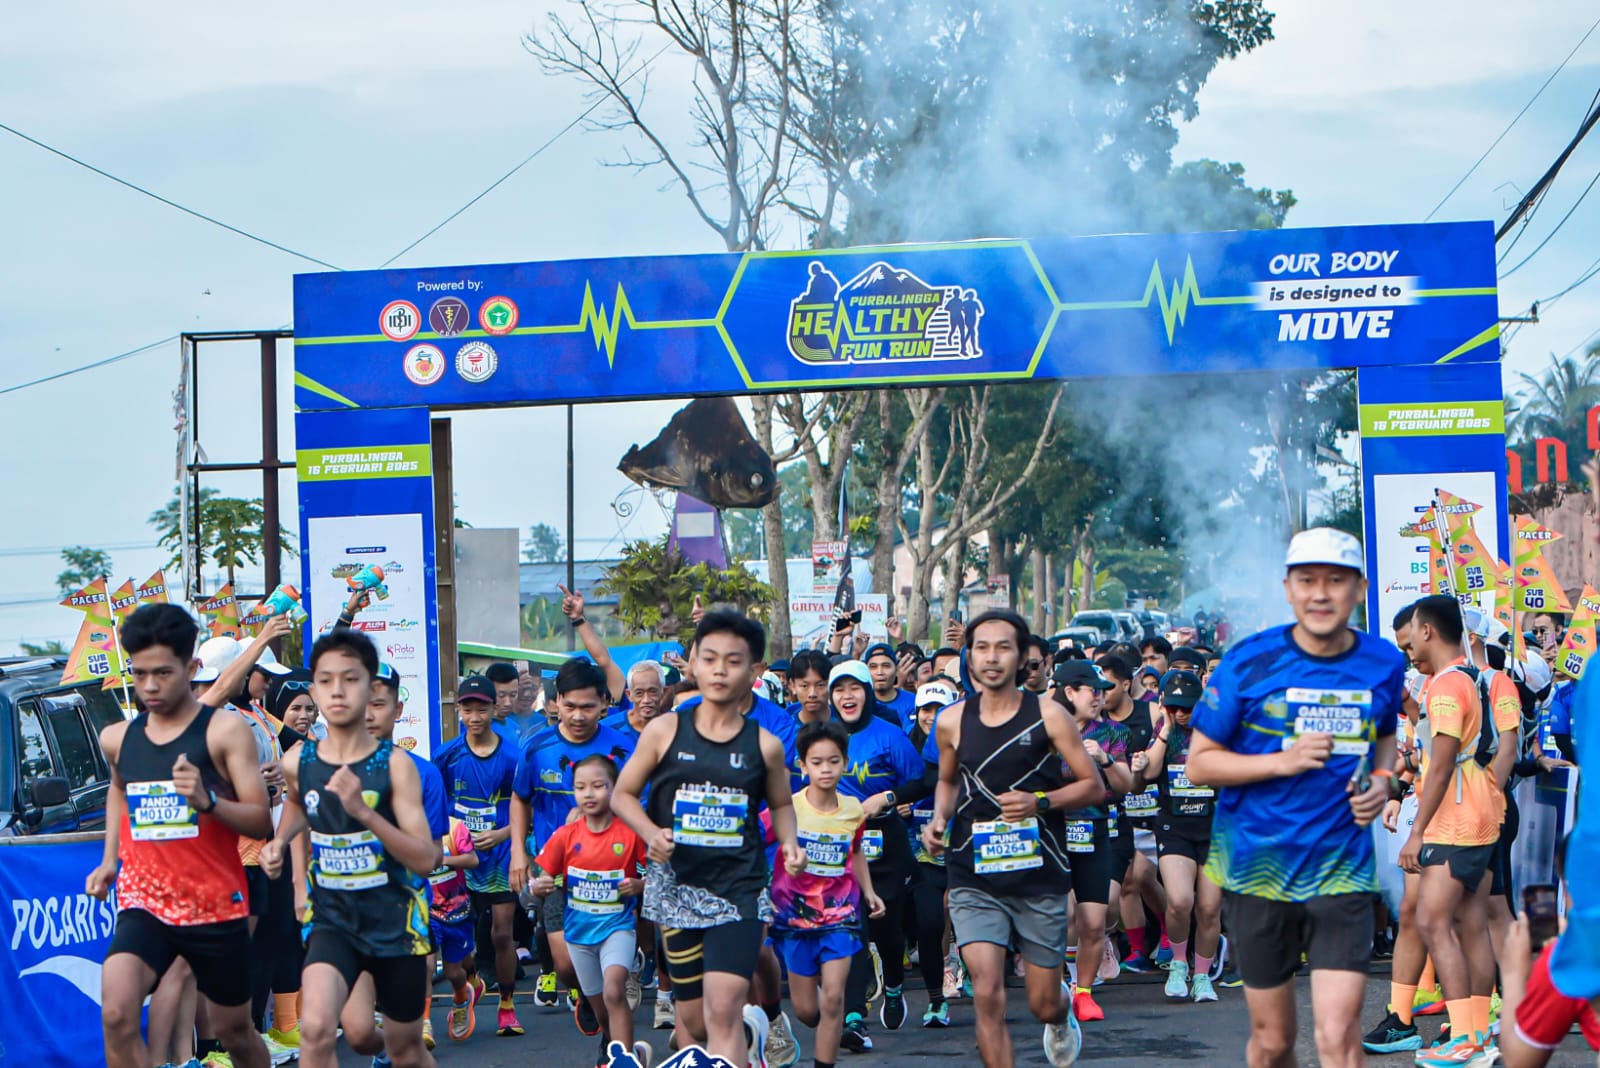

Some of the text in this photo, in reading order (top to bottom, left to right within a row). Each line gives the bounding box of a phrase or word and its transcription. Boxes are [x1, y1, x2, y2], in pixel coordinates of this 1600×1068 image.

[1268, 250, 1399, 276] OUR BODY
[417, 280, 464, 291] Powered
[1269, 285, 1401, 302] is designed to
[849, 293, 940, 307] PURBALINGGA
[792, 304, 934, 337] HEALTHY
[1278, 310, 1394, 341] MOVE
[840, 340, 934, 359] FUN RUN
[1388, 408, 1475, 420] PURBALINGGA
[1391, 419, 1453, 430] FEBRUARI
[1456, 417, 1491, 428] 2025
[322, 451, 403, 464] PURBALINGGA
[308, 461, 419, 475] 16 FEBRUARI 2025
[1445, 503, 1475, 514] PACER
[1517, 531, 1552, 540] PACER
[1466, 566, 1482, 575] SUB
[1467, 575, 1485, 589] 35
[136, 585, 163, 599] PACER
[1526, 588, 1544, 597] SUB
[71, 593, 105, 606] PACER
[111, 596, 136, 610] ACER
[206, 596, 232, 610] PACER
[1524, 597, 1545, 609] 40
[792, 603, 825, 612] GRIYA
[88, 654, 106, 663] SUB
[1568, 652, 1584, 664] SUB
[88, 662, 110, 676] 45
[1564, 659, 1582, 676] 40
[926, 688, 946, 696] FILA
[1298, 706, 1361, 718] GANTENG
[1303, 719, 1354, 732] M0309
[140, 795, 178, 808] PANDU
[140, 808, 180, 821] M0107
[698, 806, 725, 817] FIAN
[688, 816, 731, 828] M0099
[806, 841, 842, 853] DEMSKY
[986, 843, 1026, 855] M0264
[806, 851, 839, 862] M0178
[324, 859, 369, 870] M0133
[578, 880, 612, 889] HANAN
[578, 890, 611, 899] F0157
[11, 893, 97, 951] POCARI
